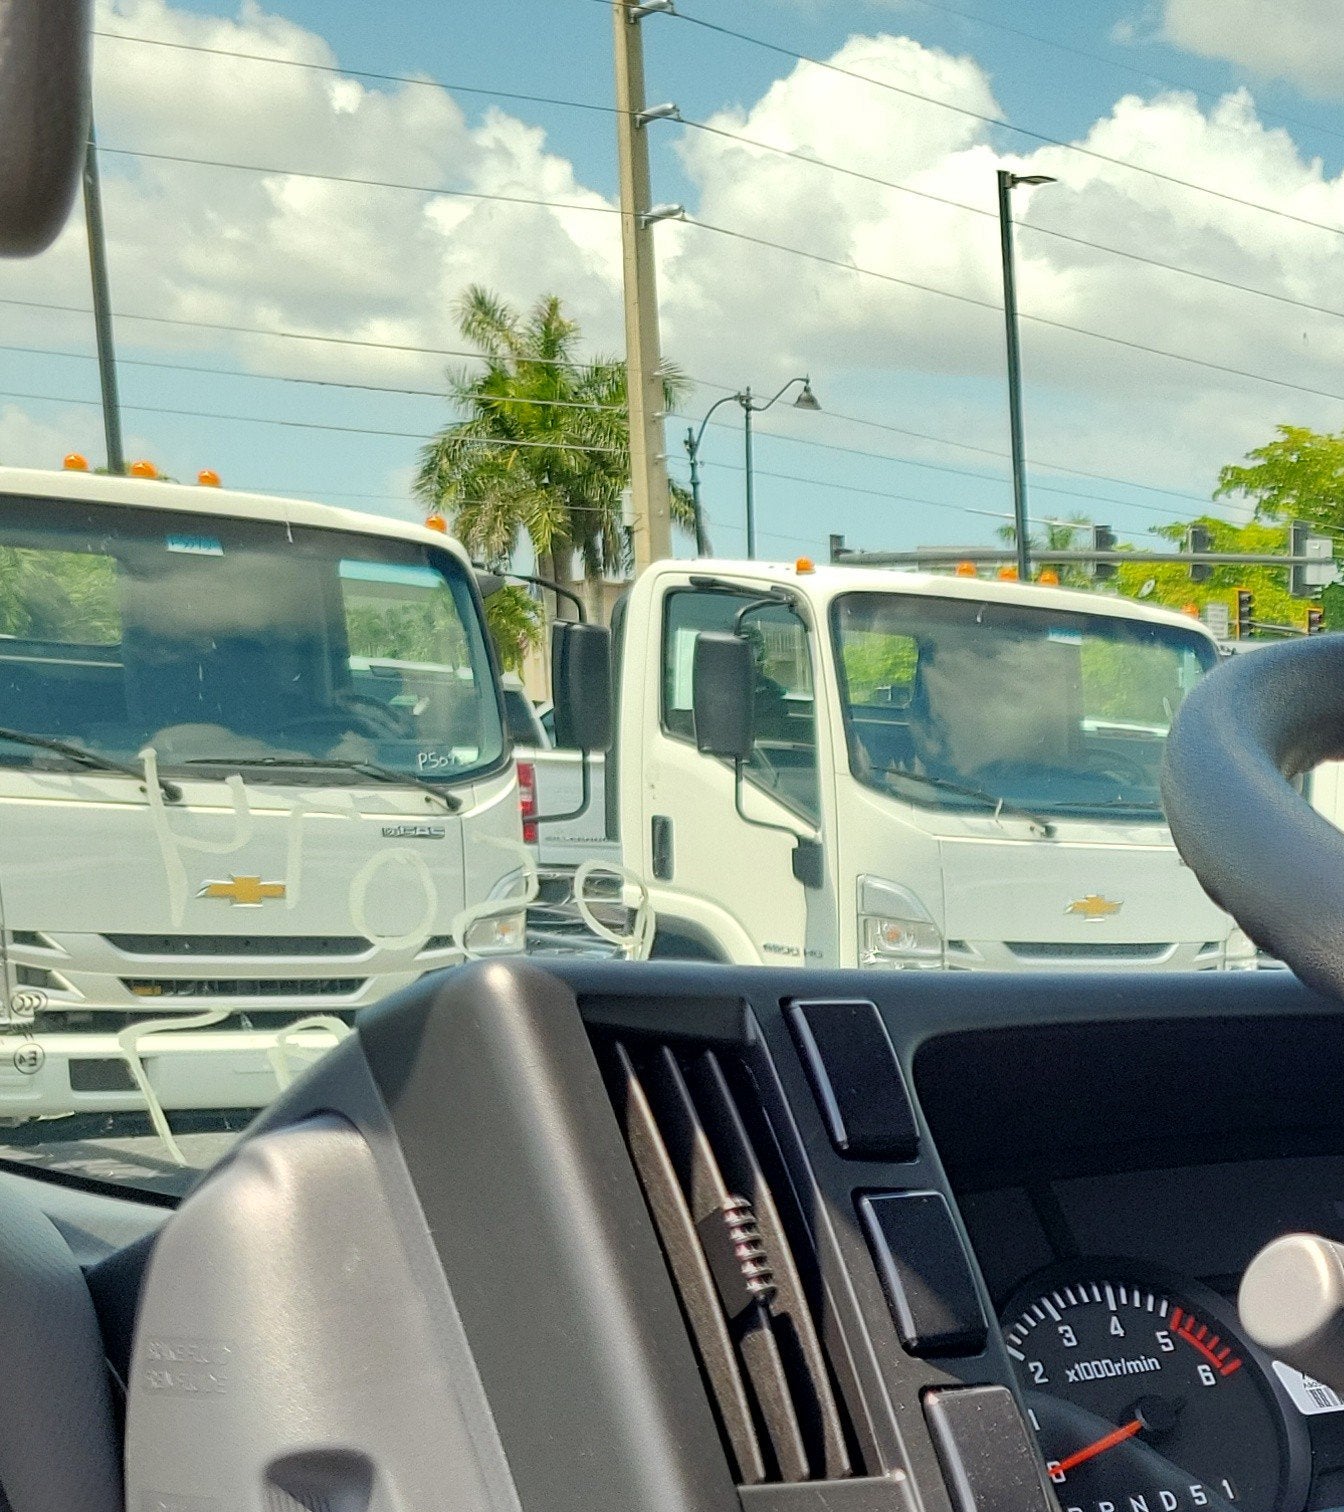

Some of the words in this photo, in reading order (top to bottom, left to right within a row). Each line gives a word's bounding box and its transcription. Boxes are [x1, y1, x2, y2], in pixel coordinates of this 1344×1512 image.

[1058, 1325, 1077, 1347] 3
[1110, 1316, 1125, 1337] 4
[1156, 1331, 1174, 1352] 5
[1030, 1362, 1049, 1384] 2
[1065, 1356, 1161, 1384] x1000r/min
[1197, 1364, 1216, 1386] 6
[1159, 1491, 1178, 1512] D
[1190, 1485, 1207, 1506] 5
[1222, 1479, 1235, 1500] 1
